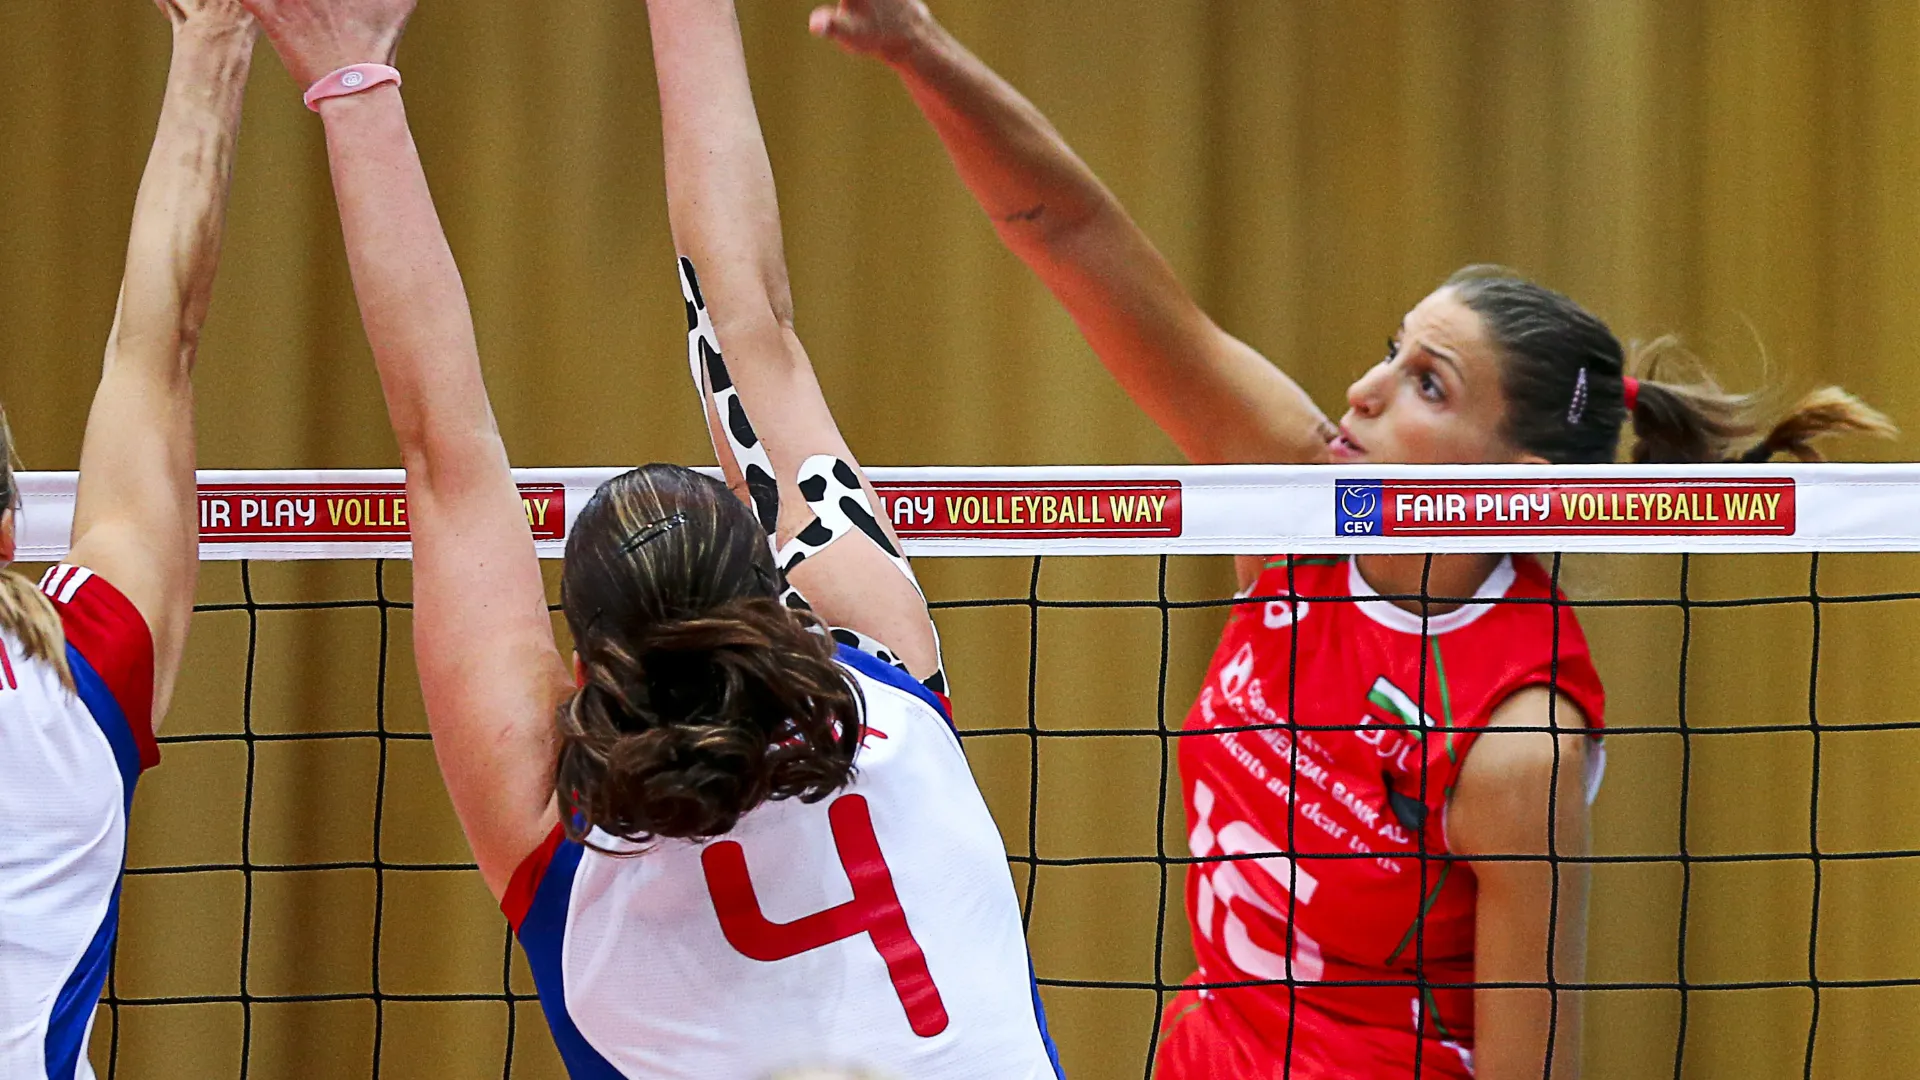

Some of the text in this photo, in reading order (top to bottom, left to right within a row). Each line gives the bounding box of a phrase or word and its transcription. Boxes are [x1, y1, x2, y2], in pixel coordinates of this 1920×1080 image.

[201, 499, 231, 528] IR
[241, 498, 316, 528] PLAY
[327, 498, 407, 526] VOLLE
[945, 495, 1105, 525] VOLLEYBALL
[1109, 495, 1168, 523] WAY
[1395, 493, 1781, 522] FAIR PLAY VOLLEYBALL WAY
[1343, 521, 1374, 534] CEV
[1331, 781, 1380, 829] BANK
[1300, 802, 1348, 840] dear
[700, 792, 950, 1038] 4
